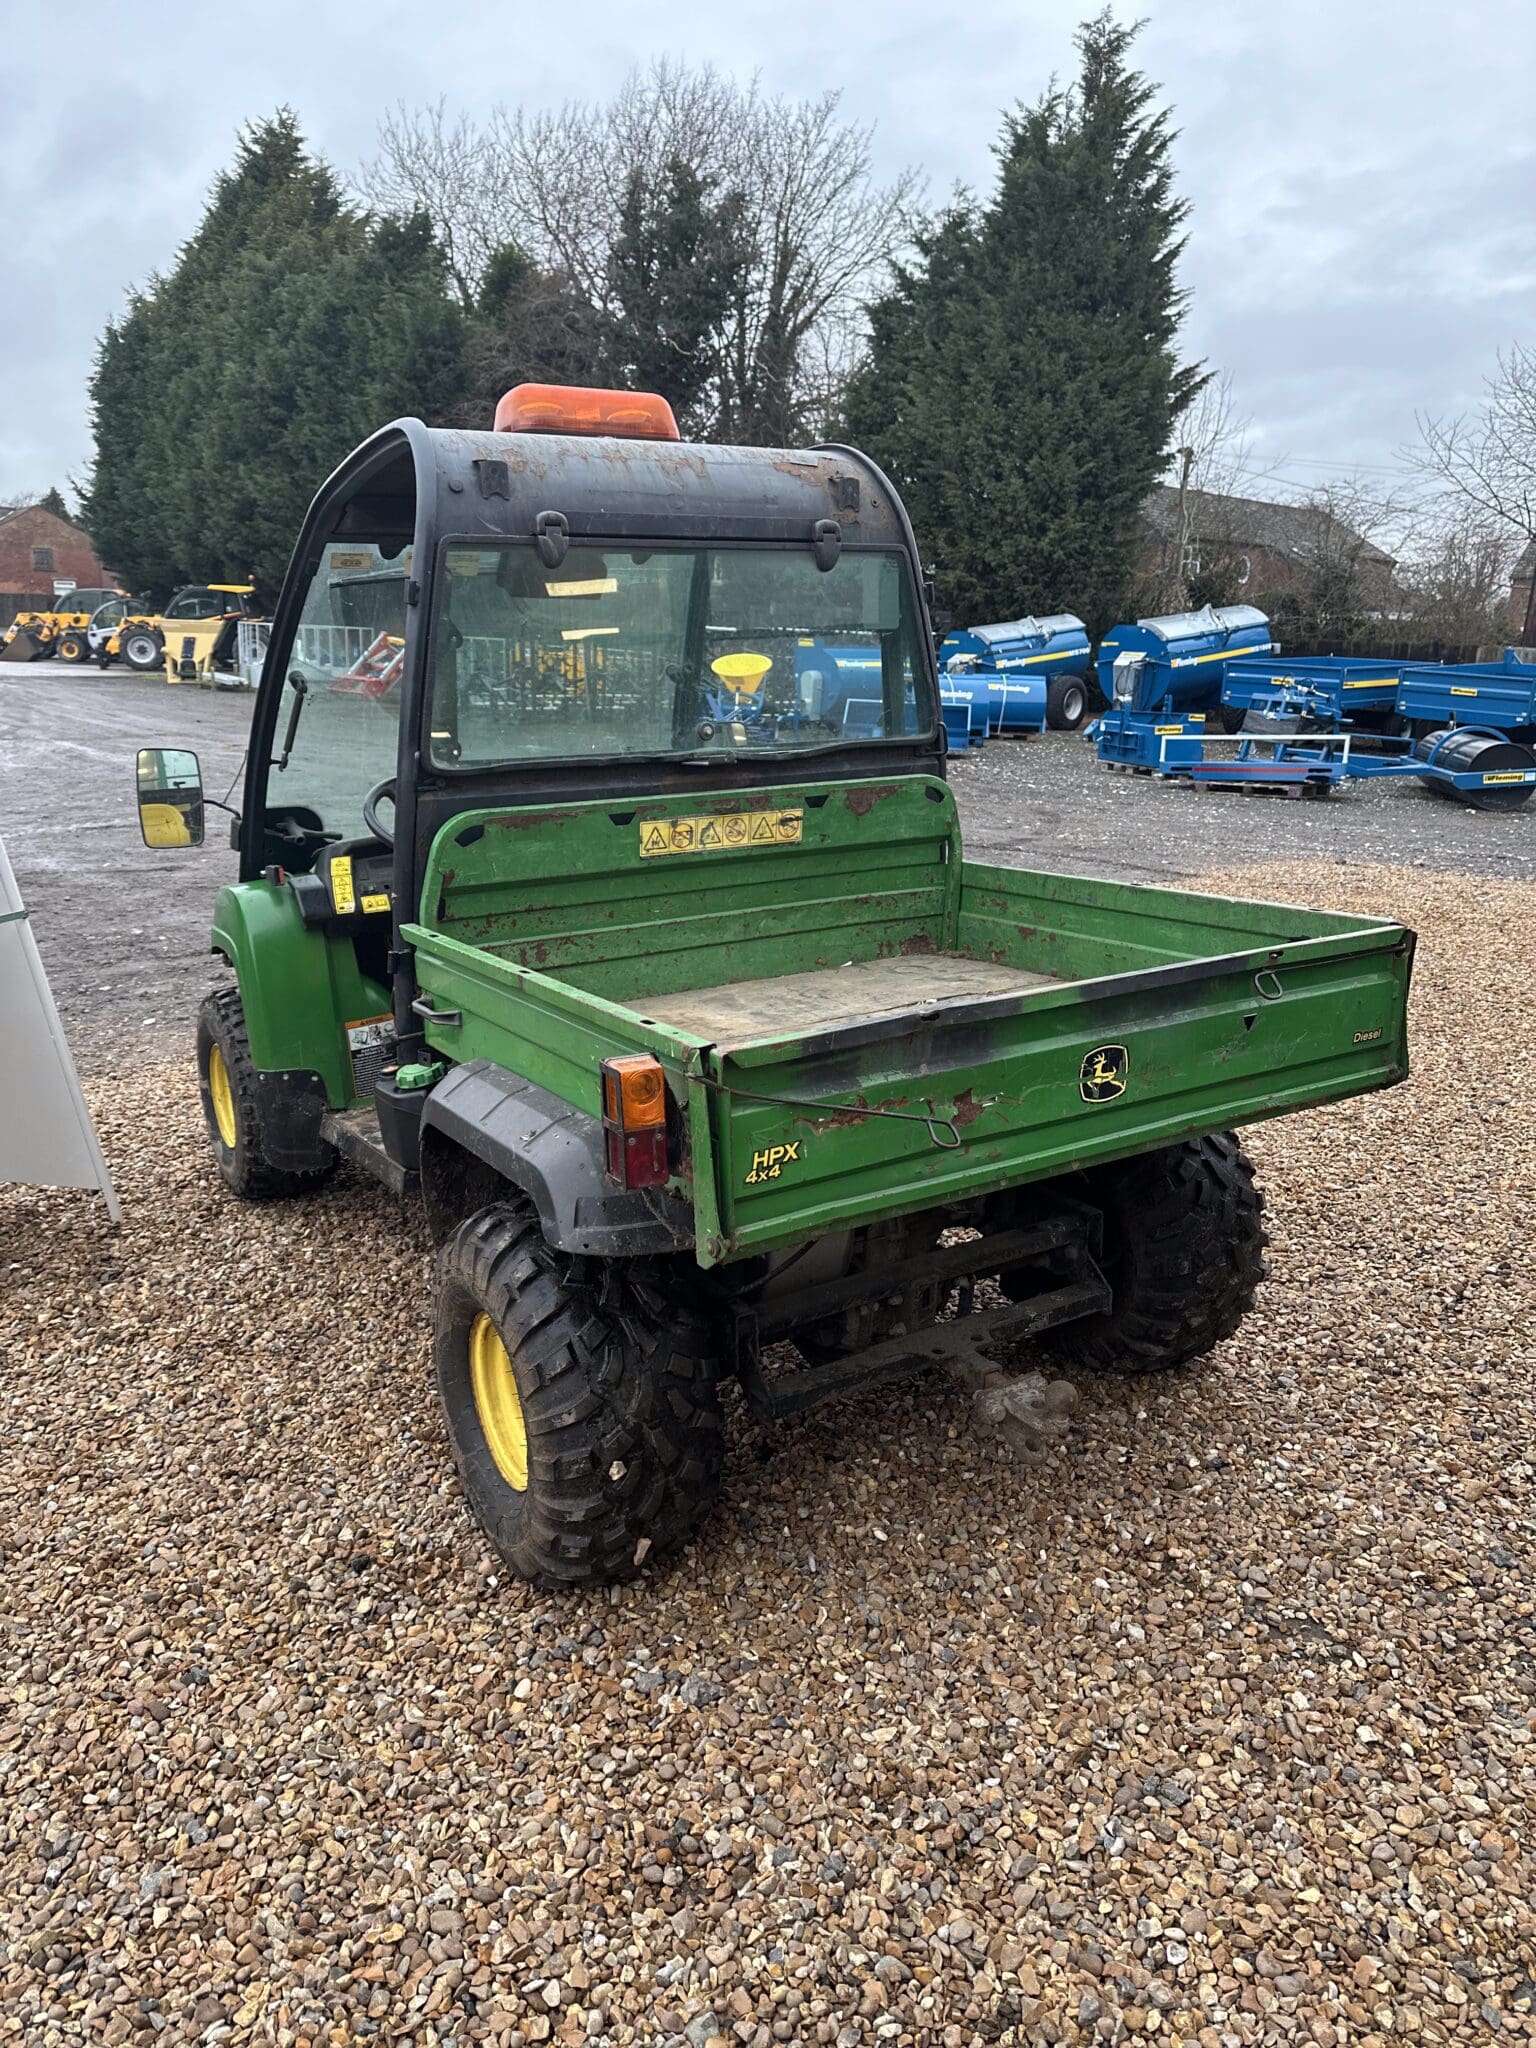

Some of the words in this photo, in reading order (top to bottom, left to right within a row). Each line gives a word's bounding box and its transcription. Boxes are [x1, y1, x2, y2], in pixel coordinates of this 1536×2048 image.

[940, 689, 974, 700] leming
[1353, 1028, 1382, 1043] Diesel
[751, 1140, 801, 1171] HPX
[744, 1163, 782, 1184] 4x4
